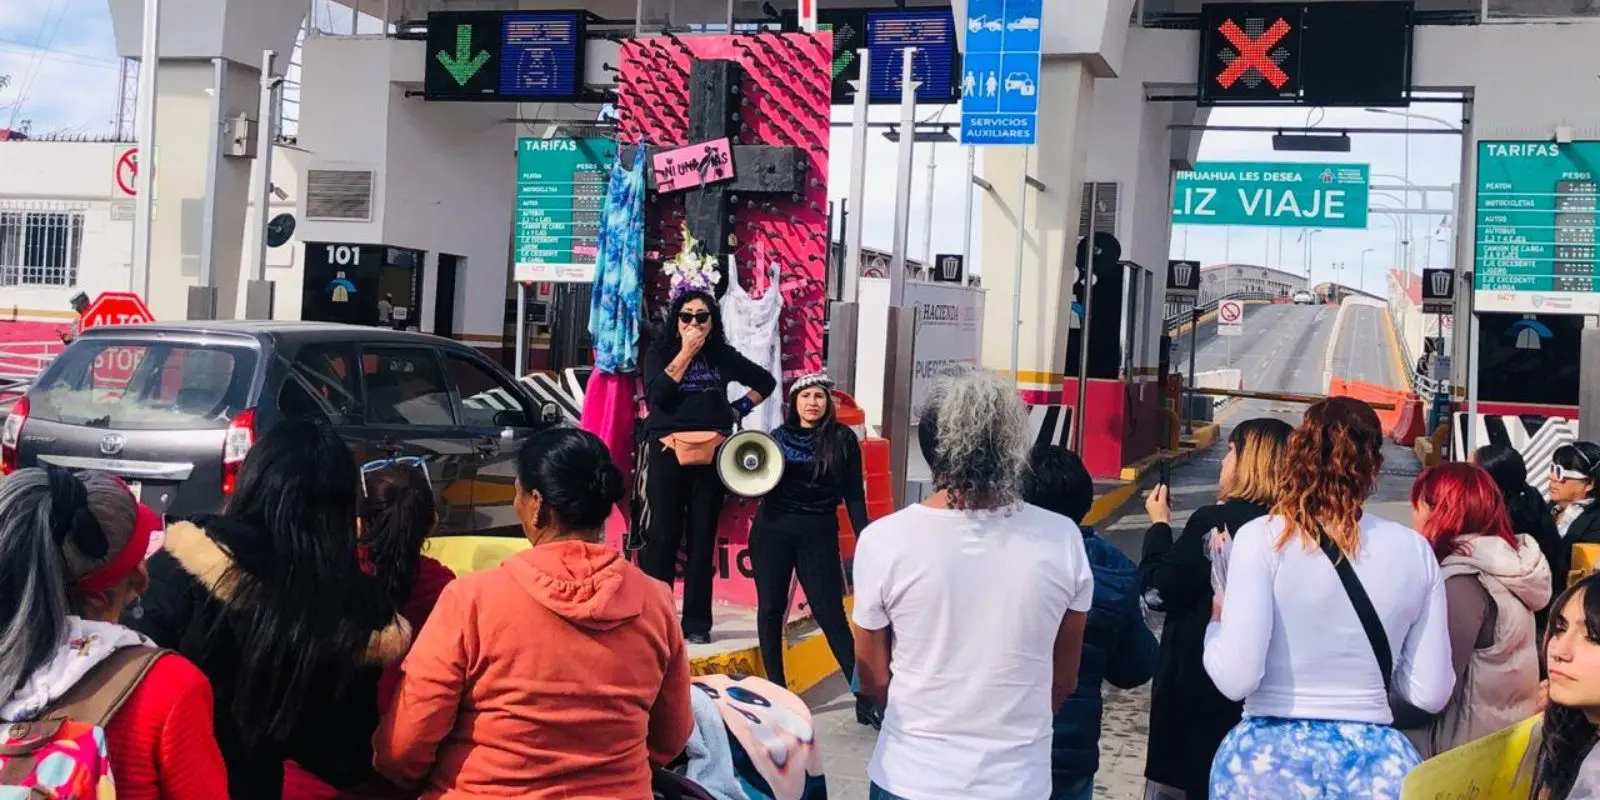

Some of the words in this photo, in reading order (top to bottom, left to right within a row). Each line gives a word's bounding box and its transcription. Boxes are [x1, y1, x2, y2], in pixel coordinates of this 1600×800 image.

[970, 118, 1029, 127] SERVICIOS
[966, 129, 1031, 138] AUXILIARES
[525, 140, 577, 151] TARIFAS
[1487, 144, 1560, 157] TARIFAS
[1240, 171, 1260, 182] LES
[1263, 172, 1303, 182] DESEA
[1562, 171, 1592, 180] PESOS
[1238, 189, 1346, 219] VIAJE
[1485, 199, 1535, 208] MOTOCICLETAS
[1485, 215, 1507, 223] AUTOS
[326, 245, 360, 266] 101
[923, 304, 960, 321] HACIENDA
